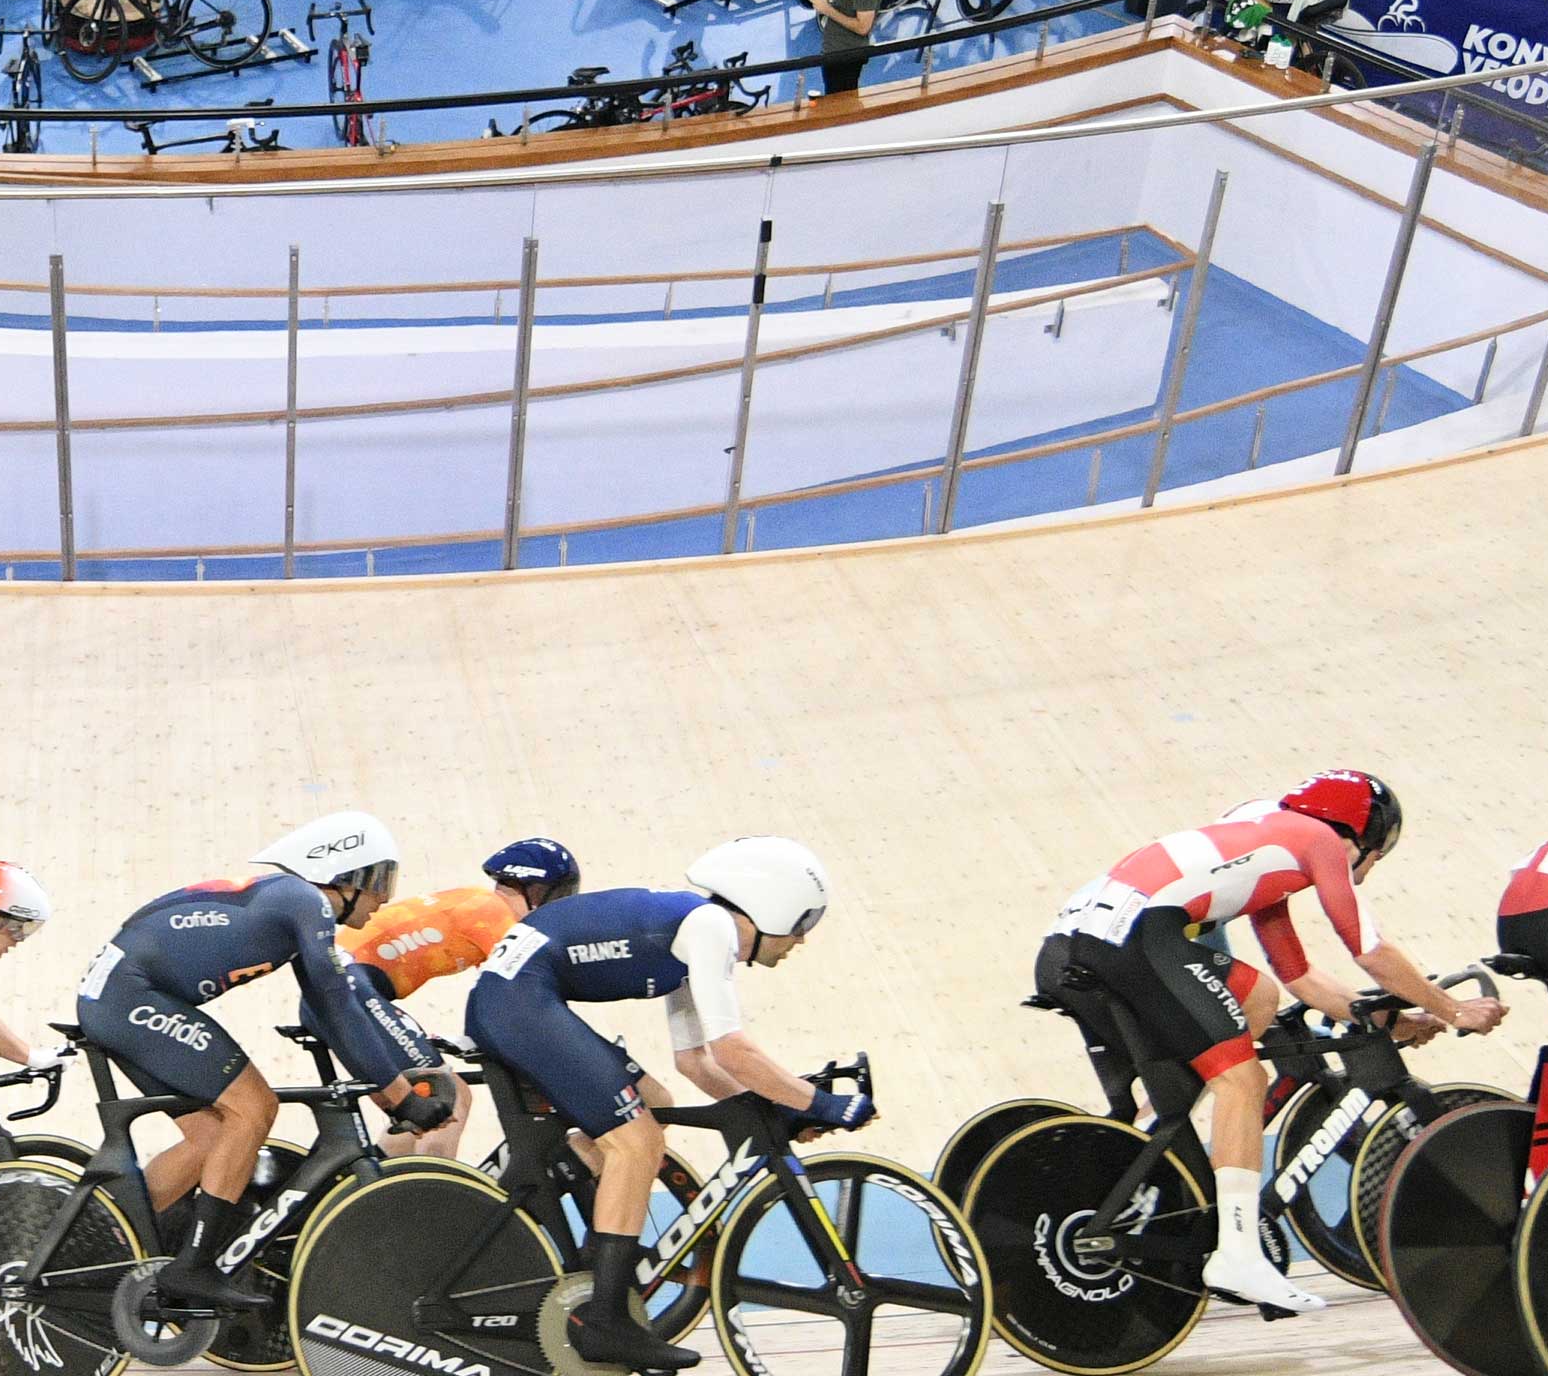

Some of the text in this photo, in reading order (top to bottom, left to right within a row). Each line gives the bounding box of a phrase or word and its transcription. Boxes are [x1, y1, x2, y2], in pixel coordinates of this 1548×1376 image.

[169, 911, 230, 930] Cofidis
[567, 938, 633, 967] FRANCE
[128, 1005, 213, 1052] Cofidis
[1184, 962, 1248, 1030] AUSTRIA
[364, 996, 434, 1069] Staatsloterij
[1276, 1087, 1369, 1199] STROMM
[638, 1135, 760, 1284] LOOK
[866, 1174, 976, 1284] CORIMA
[1034, 1213, 1135, 1302] CAMPAGNOLO
[472, 1315, 519, 1327] T20
